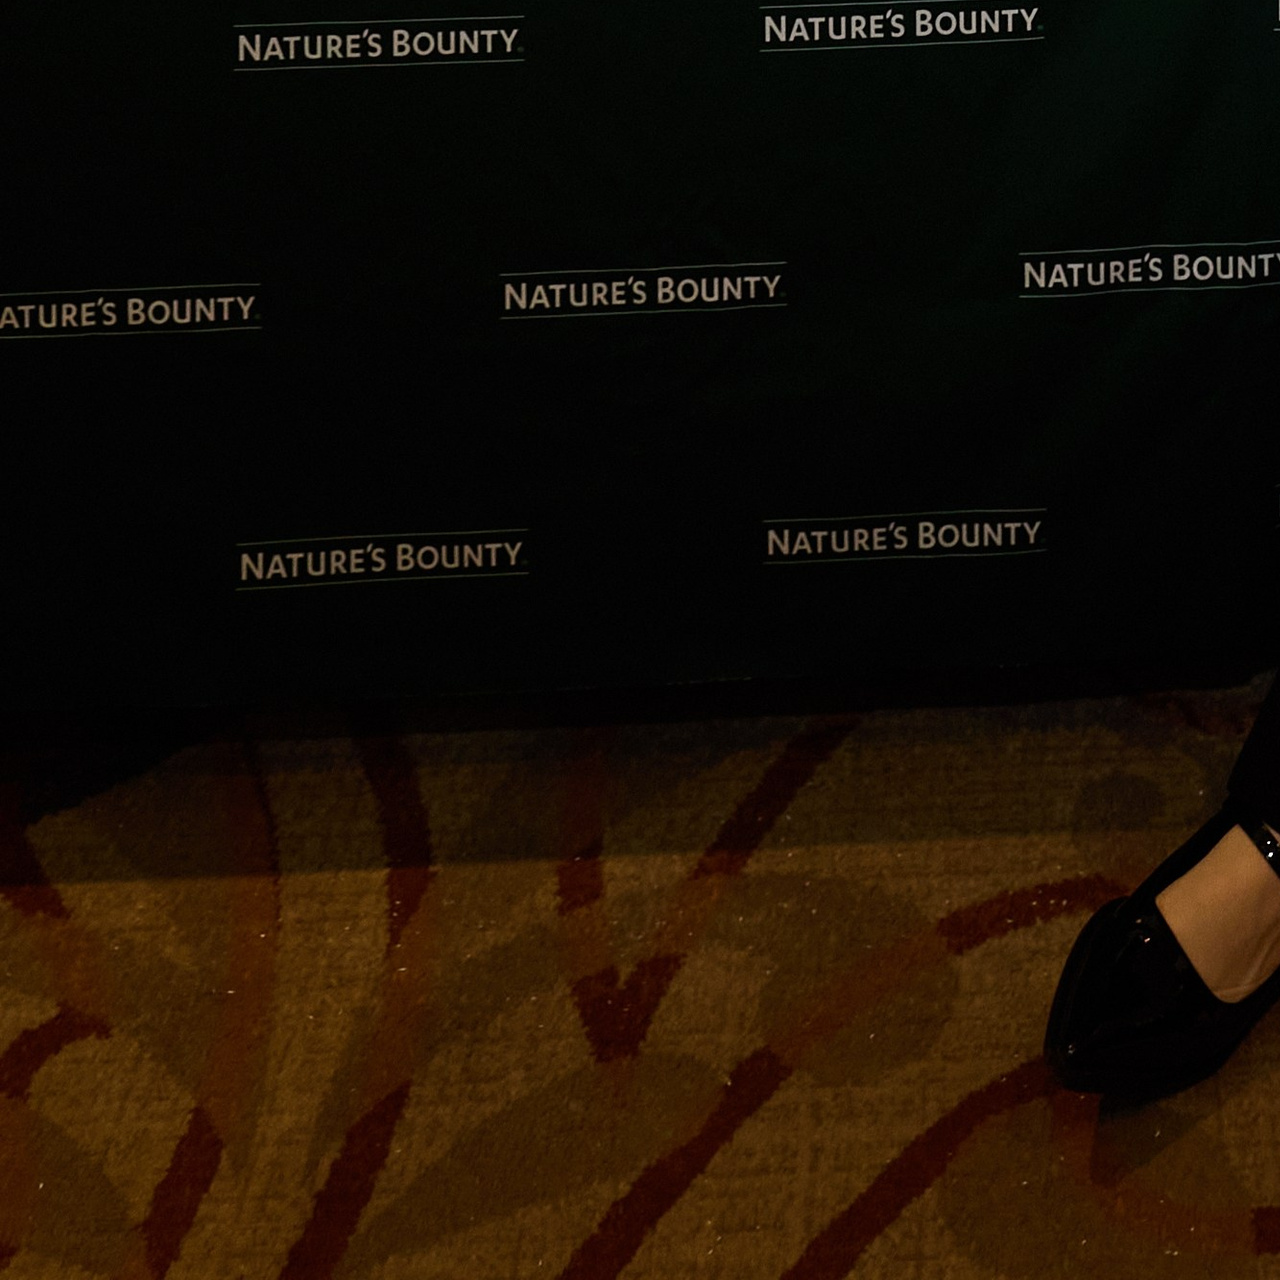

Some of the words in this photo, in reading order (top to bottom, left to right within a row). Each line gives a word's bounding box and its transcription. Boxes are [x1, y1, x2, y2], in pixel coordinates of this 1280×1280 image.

[764, 9, 905, 42] NATURE'S
[238, 29, 383, 62] NATURE'S
[1023, 252, 1164, 288] NATURE'S
[504, 276, 648, 311] NATURE'S
[767, 521, 908, 557] NATURE'S
[241, 543, 386, 581] NATURE'S
